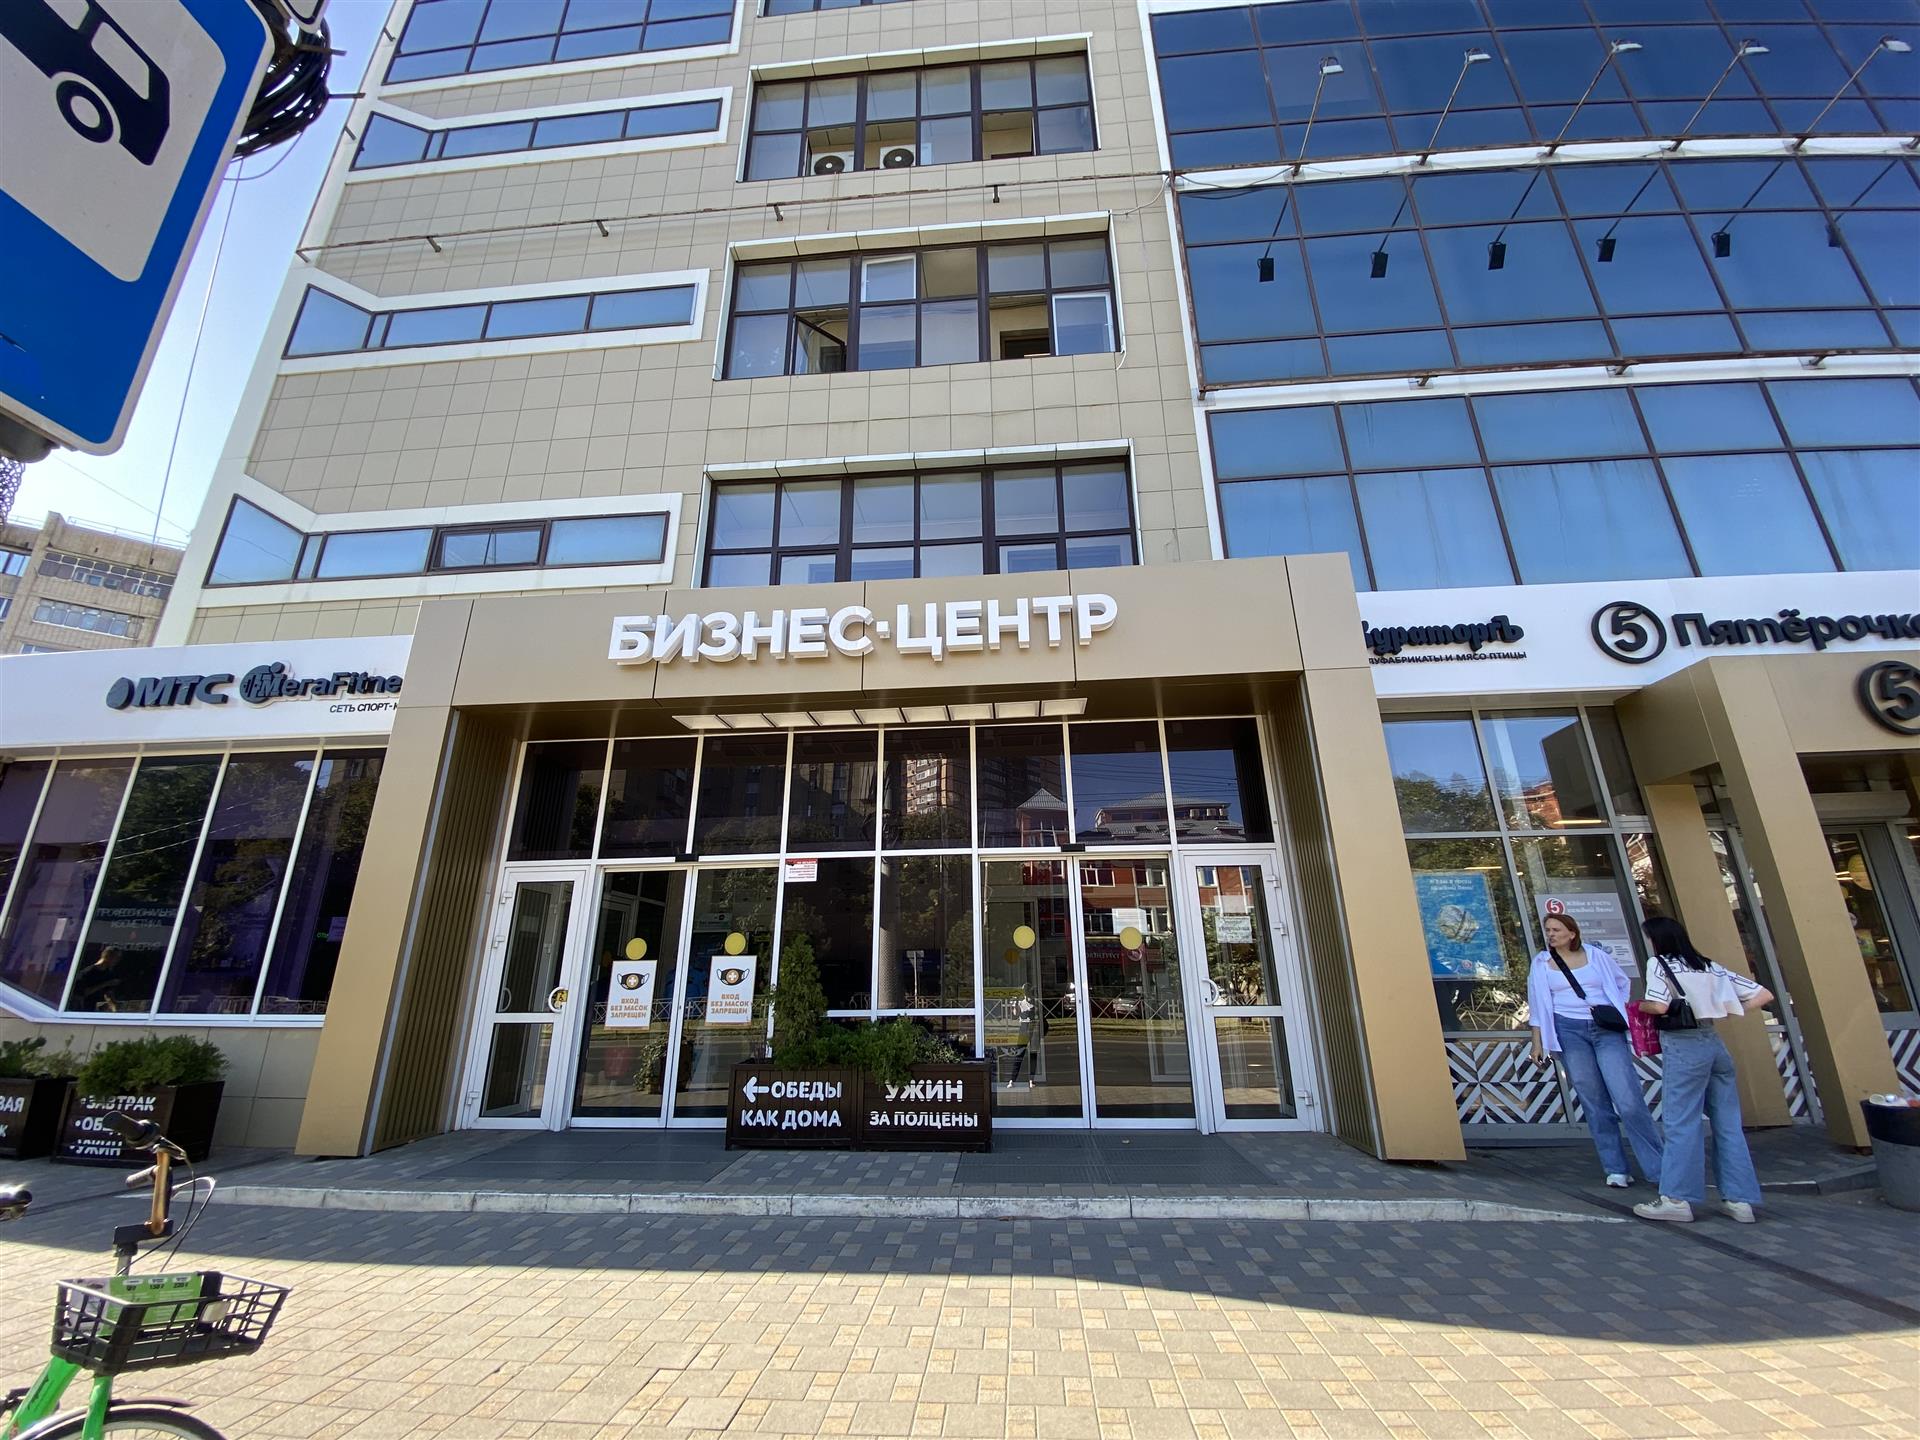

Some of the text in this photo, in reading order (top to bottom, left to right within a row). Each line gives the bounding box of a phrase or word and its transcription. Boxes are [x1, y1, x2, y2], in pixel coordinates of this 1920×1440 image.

[1456, 653, 1487, 661] МЯСО
[1489, 651, 1527, 660] ПТИЦЫ
[132, 674, 234, 707] МТС
[329, 704, 356, 713] СЕТЬ
[711, 1007, 747, 1015] ЗАПРЕЩЕН
[771, 1081, 842, 1101] ОБЕДЫ
[885, 1080, 963, 1102] УЖИН
[741, 1110, 842, 1130] КАК ДОМА
[869, 1111, 978, 1129] ЗА ПОЛЦЕНЫ
